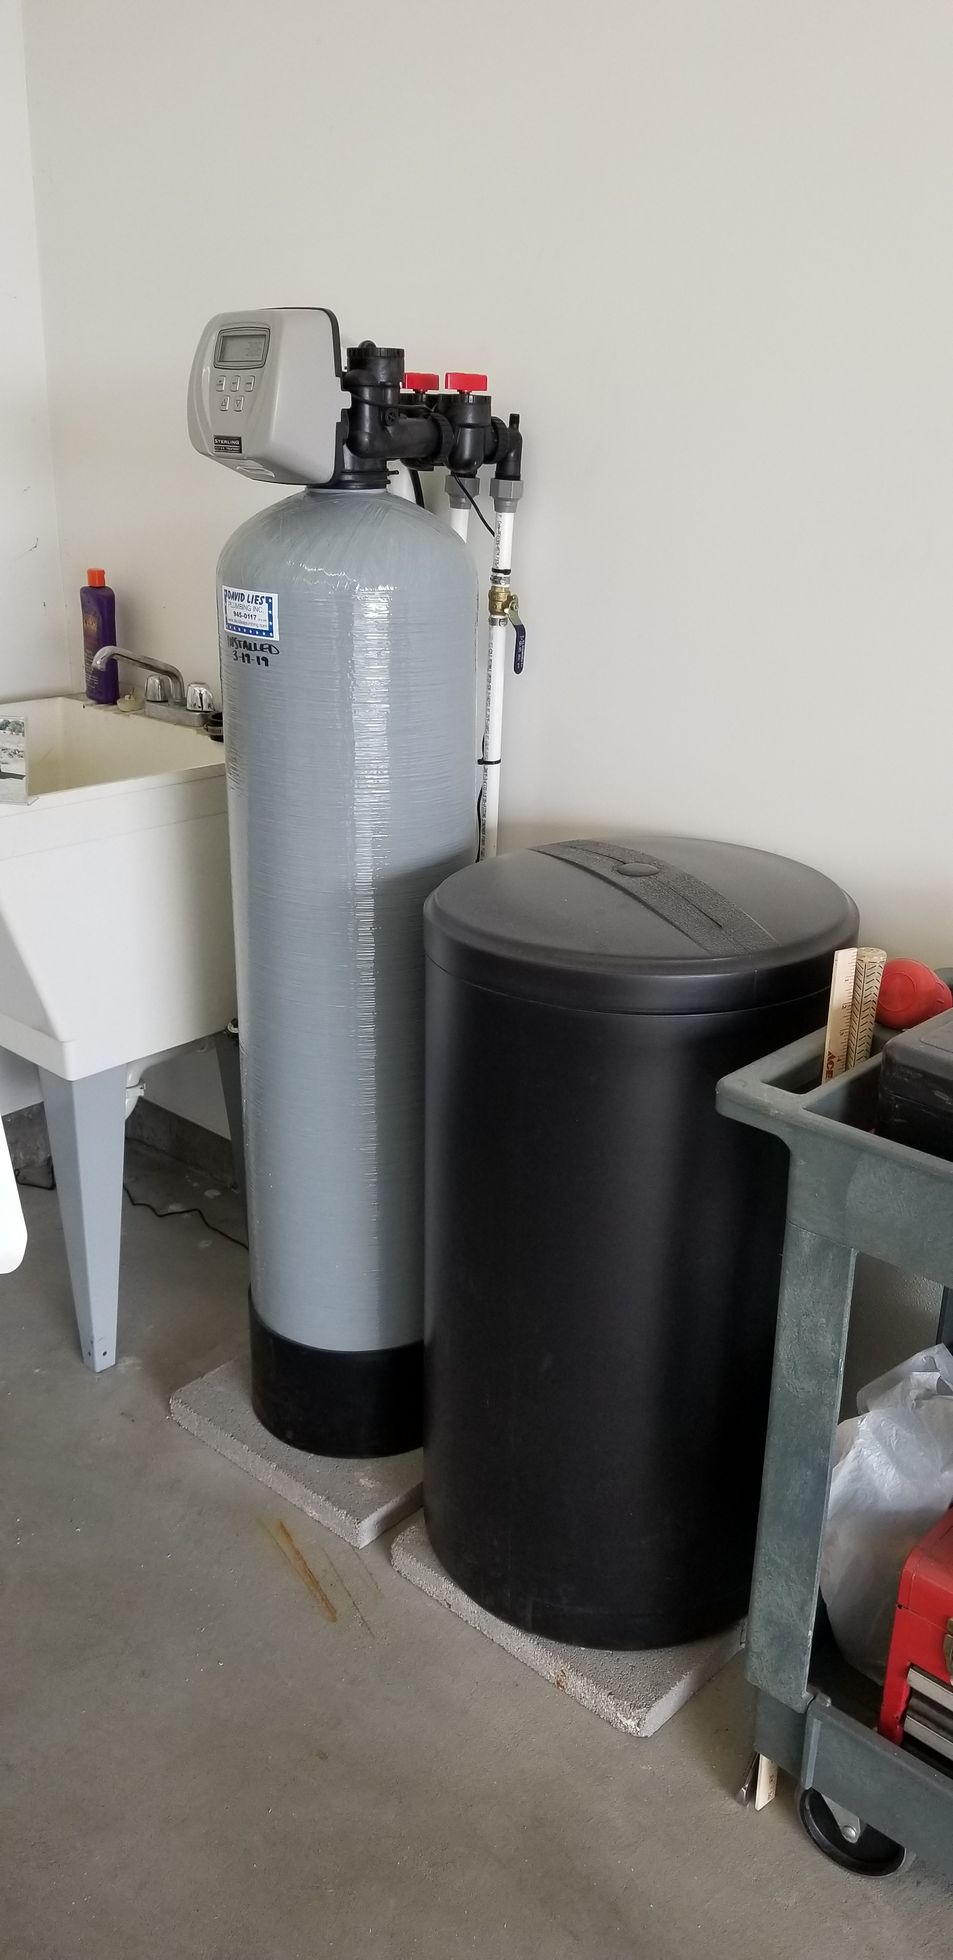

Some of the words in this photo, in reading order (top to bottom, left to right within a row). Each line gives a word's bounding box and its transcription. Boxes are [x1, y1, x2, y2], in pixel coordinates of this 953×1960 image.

[227, 590, 245, 603] DAVID
[246, 593, 265, 605] LIES
[227, 601, 251, 611] PLUMBING
[233, 610, 257, 620] 945-0117
[226, 635, 280, 655] INSTALLED
[232, 650, 269, 667] 3-19-19
[825, 1050, 837, 1079] ACE
